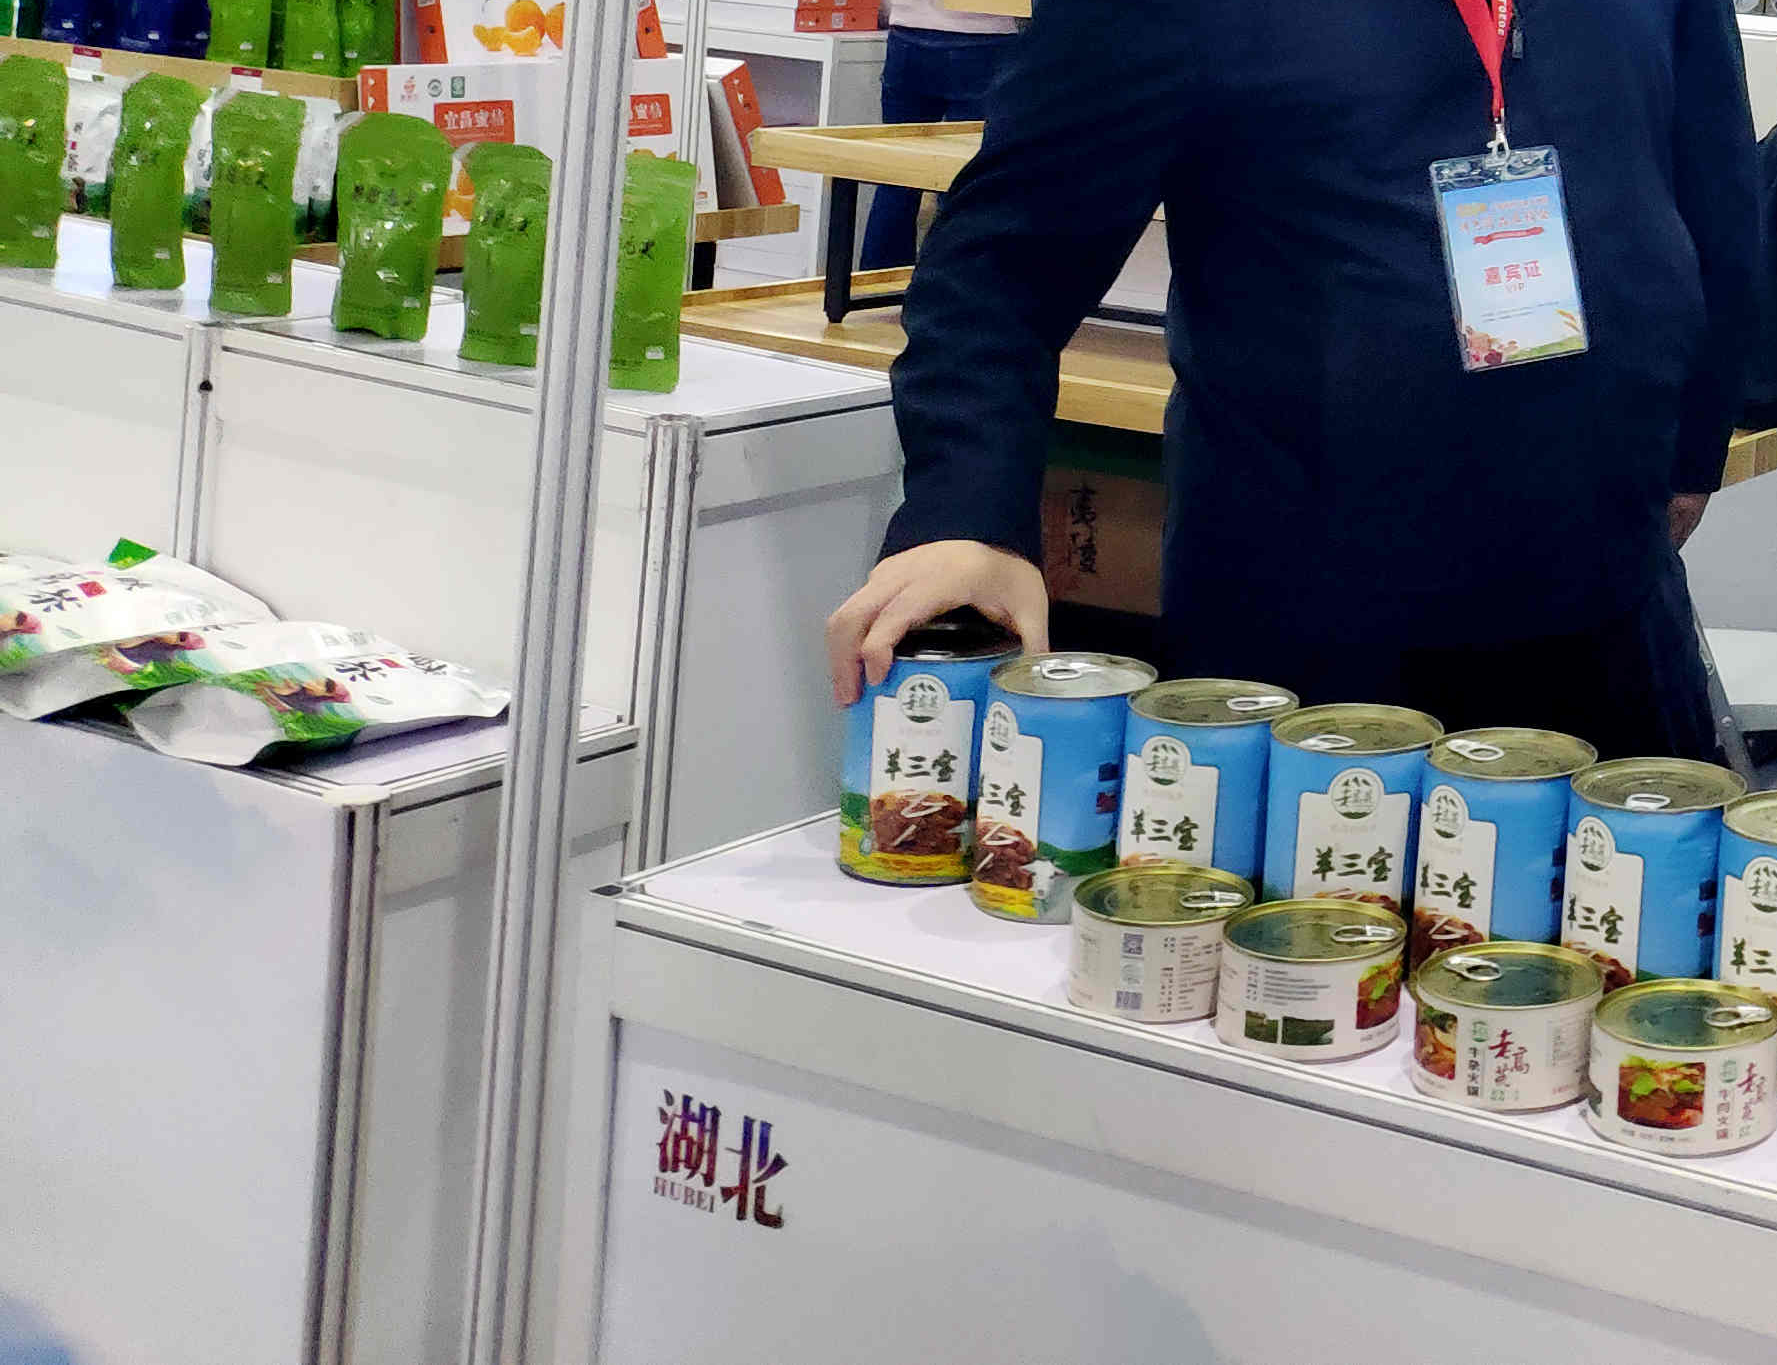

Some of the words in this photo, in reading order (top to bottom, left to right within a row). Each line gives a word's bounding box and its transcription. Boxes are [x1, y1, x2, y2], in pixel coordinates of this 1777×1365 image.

[443, 108, 505, 131] 宜昌蜜桔
[1484, 260, 1542, 286] 嘉宾证
[884, 747, 957, 782] 羊三宝
[1130, 812, 1199, 852] 羊三宝
[1312, 846, 1392, 884] 羊三宝
[655, 1088, 789, 1230] 湖北
[653, 1176, 715, 1214] HUBEI
